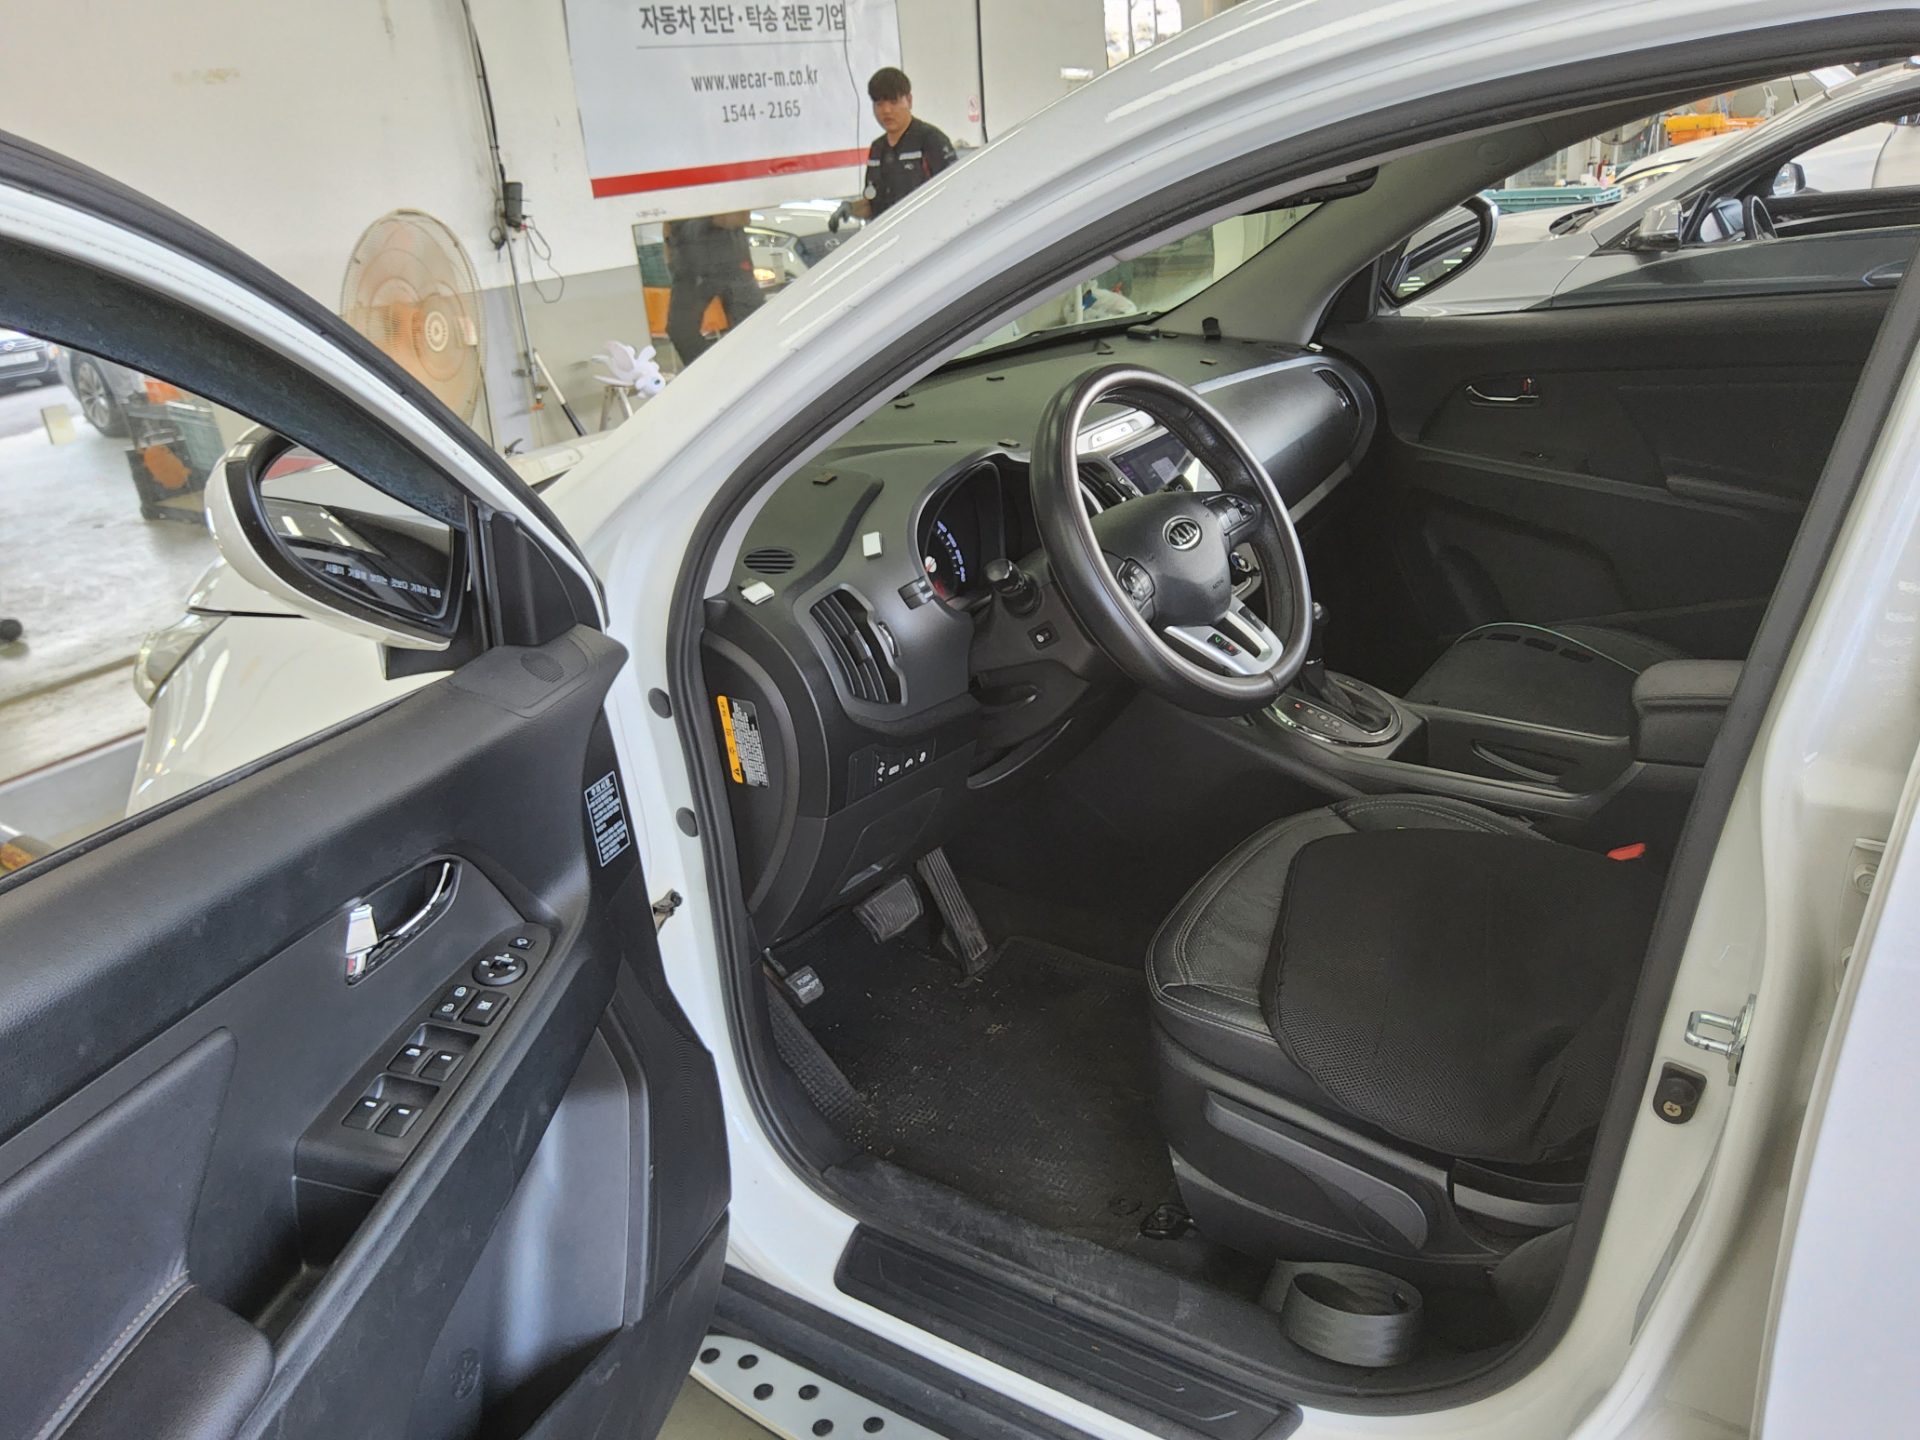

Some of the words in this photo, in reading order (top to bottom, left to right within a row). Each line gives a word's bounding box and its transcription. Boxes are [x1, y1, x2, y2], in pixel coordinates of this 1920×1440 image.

[639, 4, 696, 35] 자동차
[781, 4, 813, 32] 전문
[815, 3, 846, 31] 기업
[691, 64, 818, 92] www.wecar-m.co.kr
